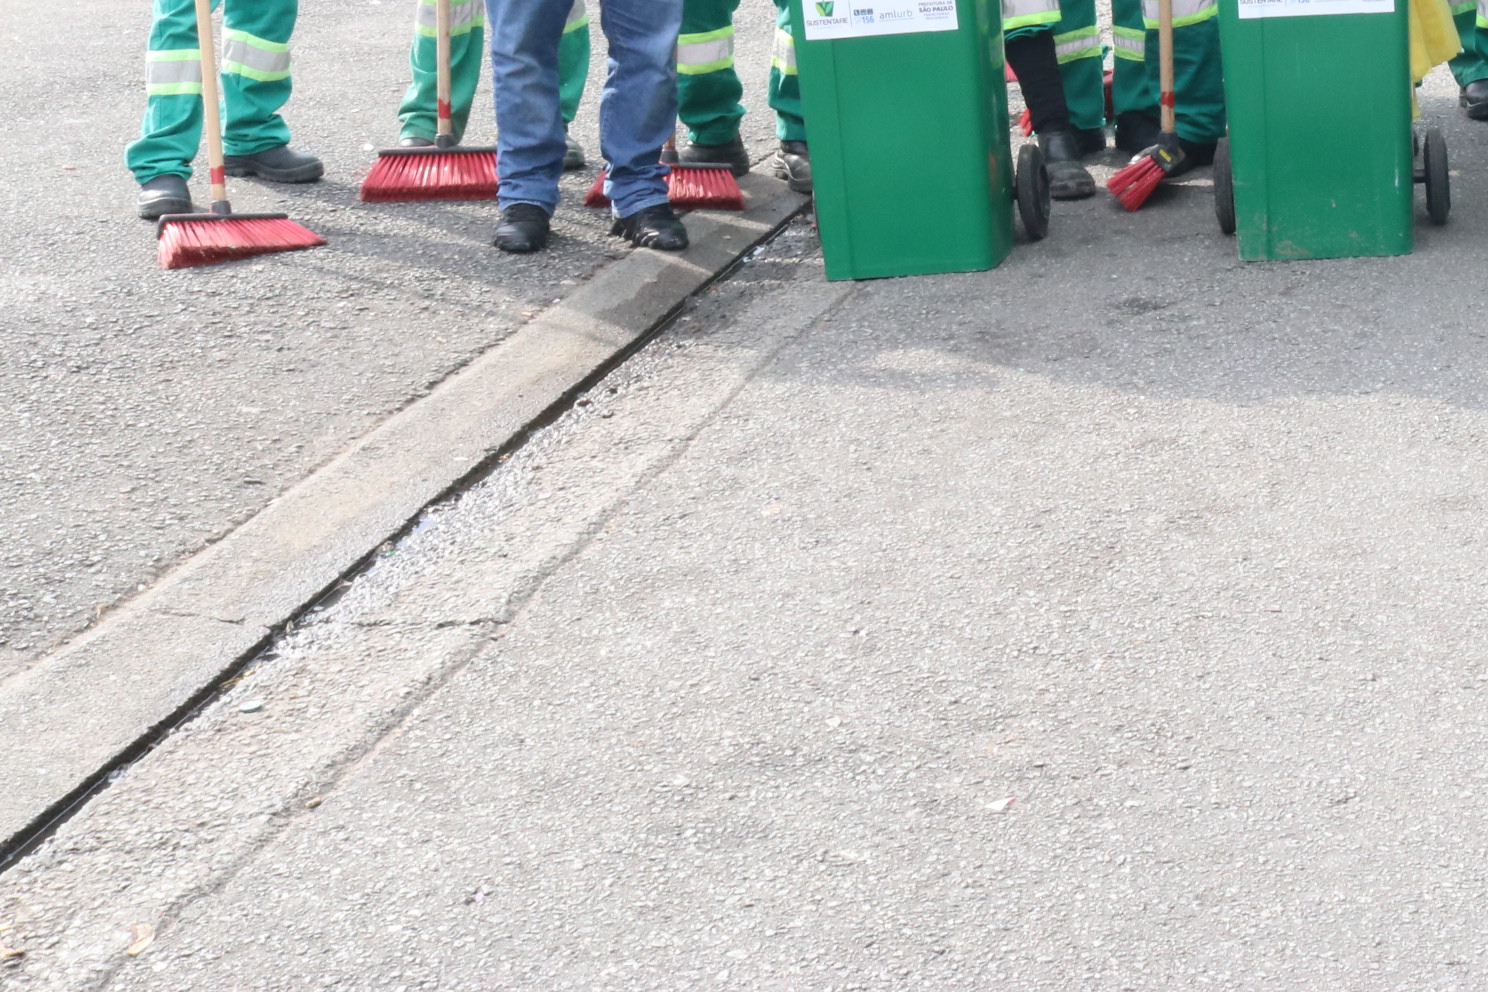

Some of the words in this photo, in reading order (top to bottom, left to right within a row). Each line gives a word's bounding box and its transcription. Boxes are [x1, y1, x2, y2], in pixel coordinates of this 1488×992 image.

[919, 5, 932, 13] SÃO
[880, 8, 912, 20] amlurb
[806, 17, 848, 26] SUSTENTARE
